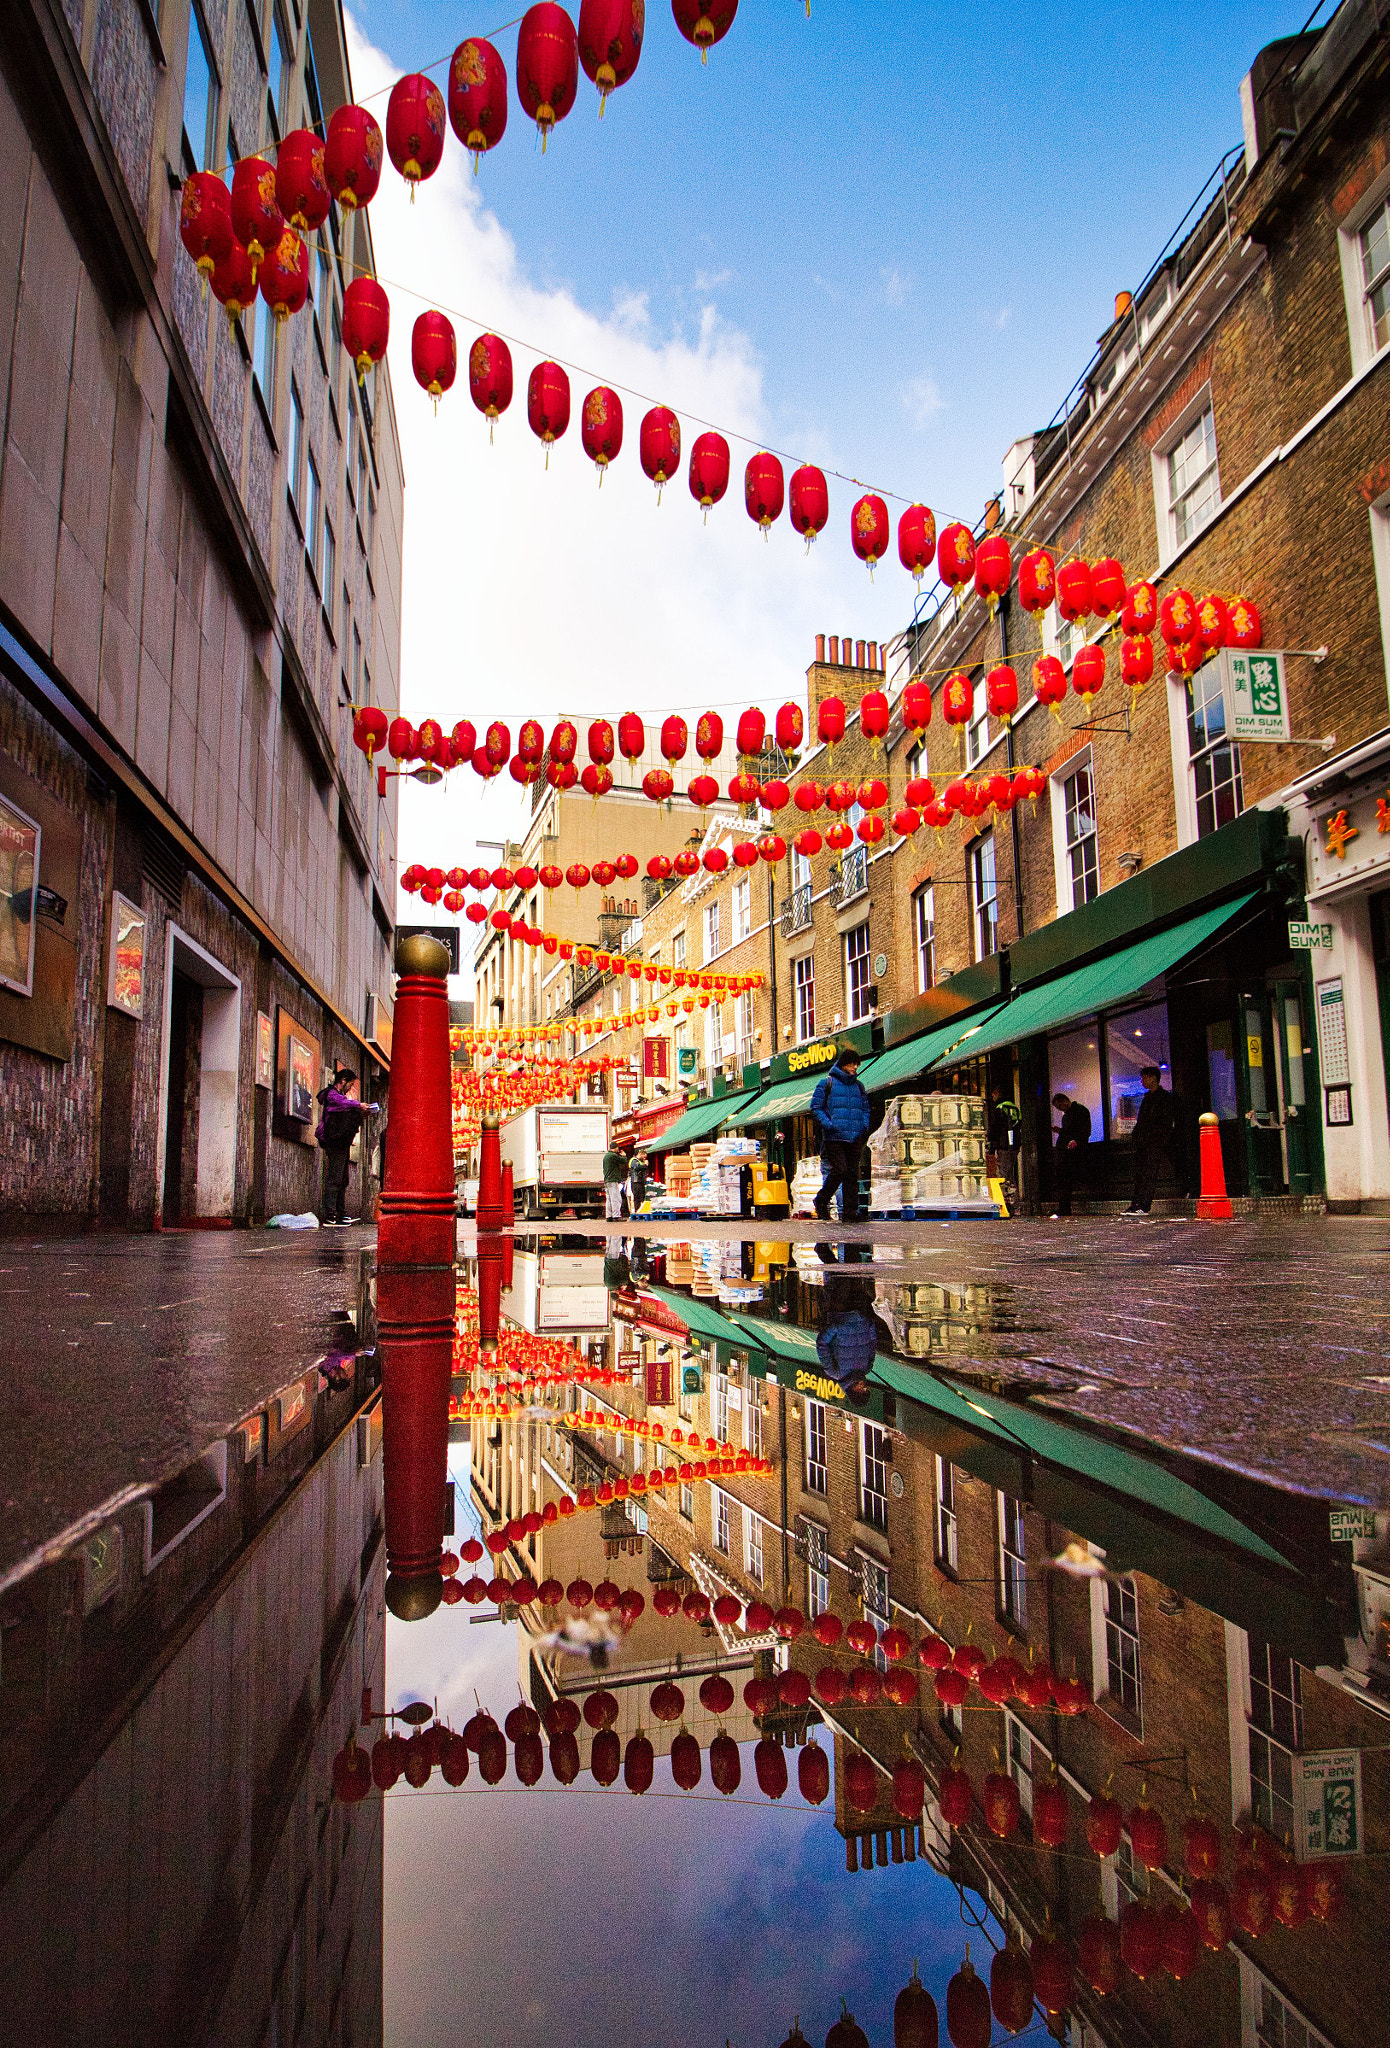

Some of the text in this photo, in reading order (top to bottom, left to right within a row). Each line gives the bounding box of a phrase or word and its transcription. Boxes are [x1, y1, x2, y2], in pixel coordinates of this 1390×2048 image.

[1232, 659, 1248, 693] 精美
[1250, 660, 1279, 712] 點心
[1235, 717, 1283, 727] DIM SUM
[1235, 727, 1284, 736] Served Daily
[1290, 923, 1319, 934] DIM
[1291, 936, 1320, 947] SUM
[788, 1044, 837, 1072] SeeWoo
